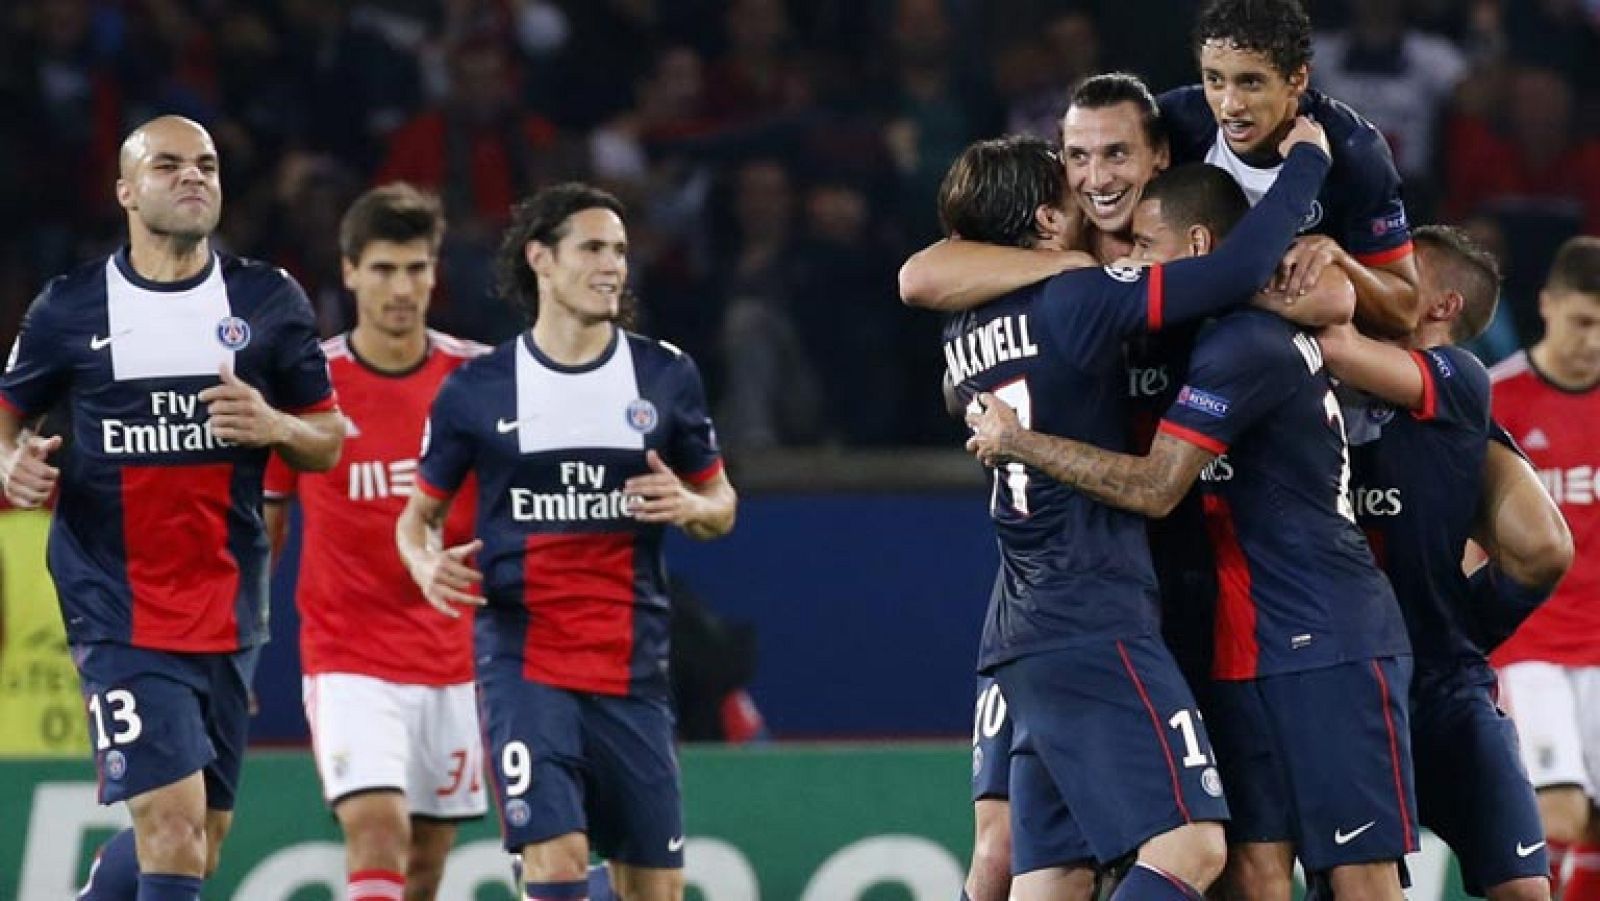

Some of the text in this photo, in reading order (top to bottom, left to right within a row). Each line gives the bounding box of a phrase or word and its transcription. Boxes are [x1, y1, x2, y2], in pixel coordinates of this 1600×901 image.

[943, 314, 1039, 388] MAXWELL
[151, 390, 197, 418] Fly
[101, 416, 238, 454] Emirat
[348, 458, 417, 502] ME
[560, 461, 605, 489] Fly
[89, 689, 142, 750] 13
[501, 741, 531, 796] 9
